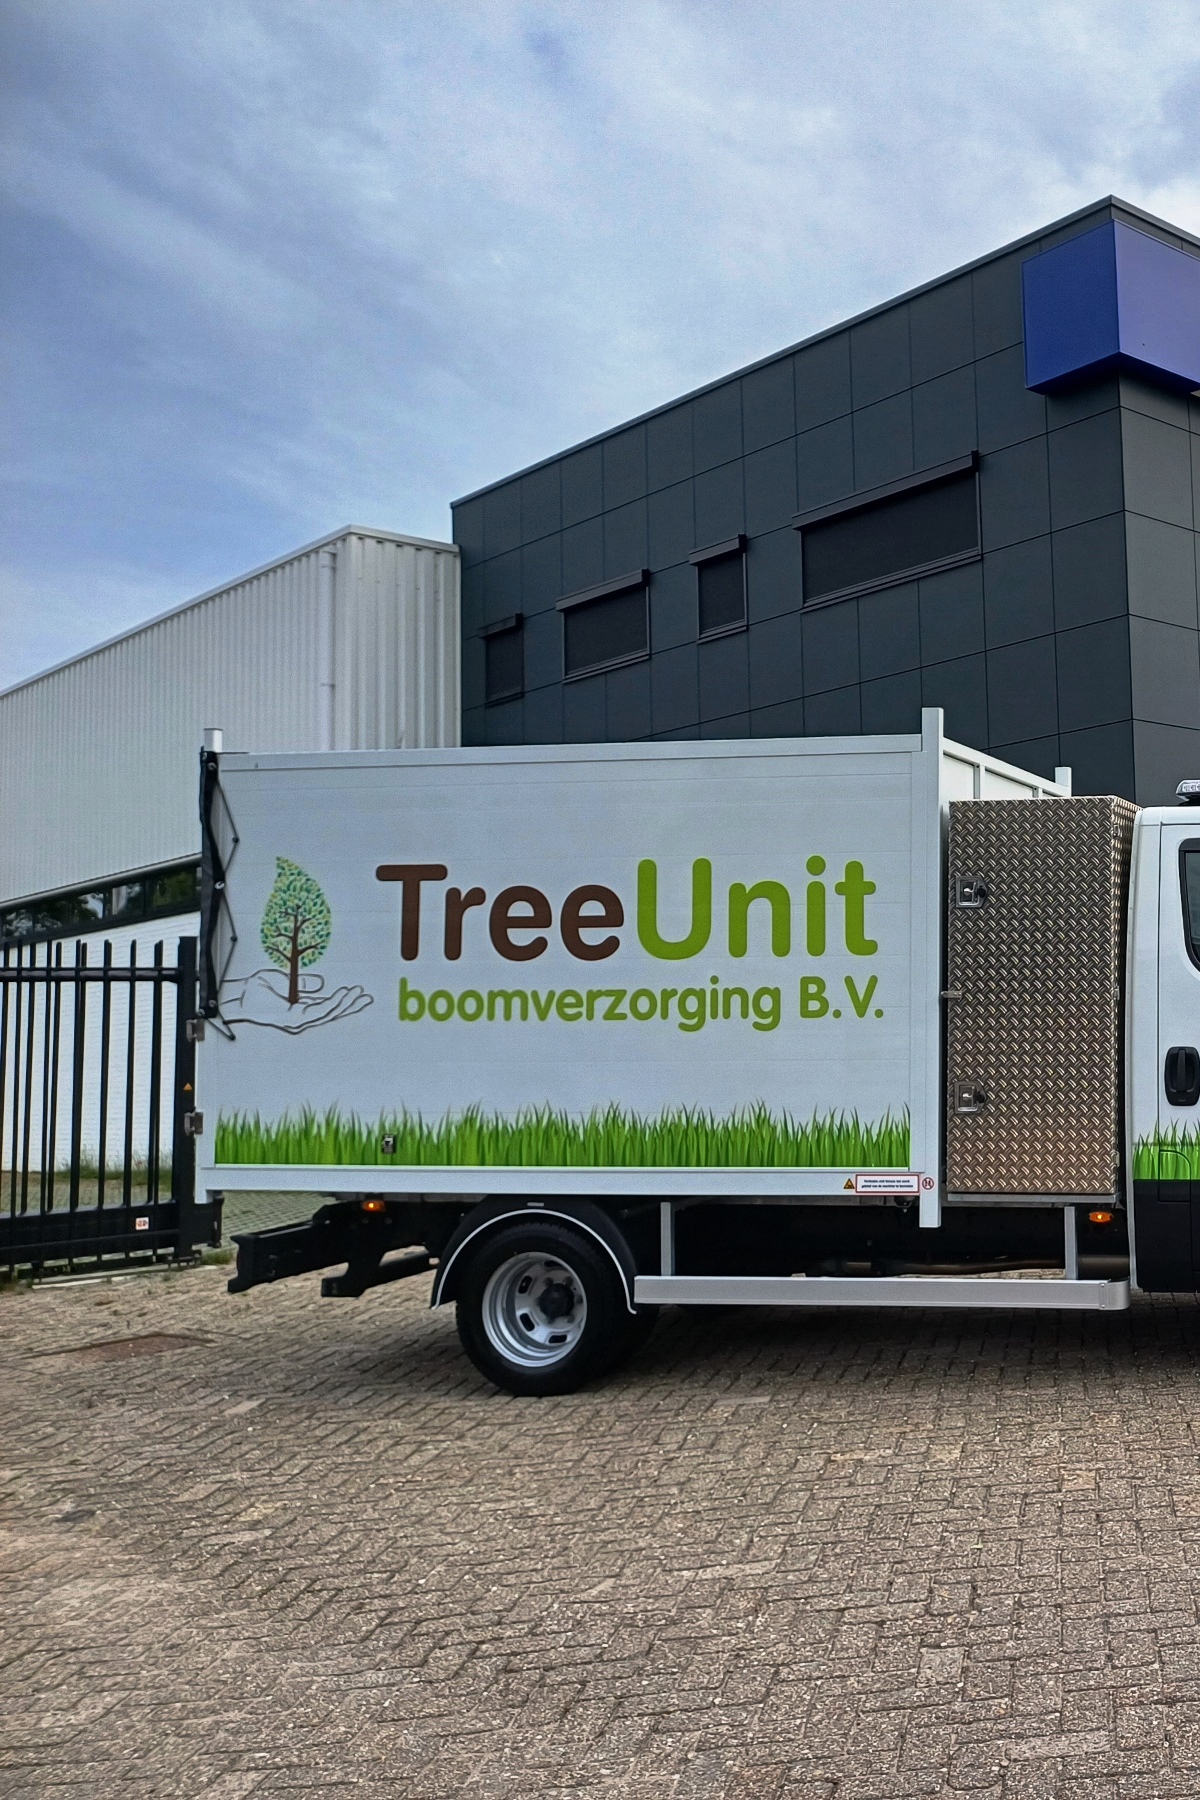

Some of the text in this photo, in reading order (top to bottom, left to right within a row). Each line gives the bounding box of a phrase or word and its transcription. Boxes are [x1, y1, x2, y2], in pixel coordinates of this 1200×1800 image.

[376, 855, 879, 962] TreeUnit
[398, 975, 885, 1032] boomverzorging B.V.
